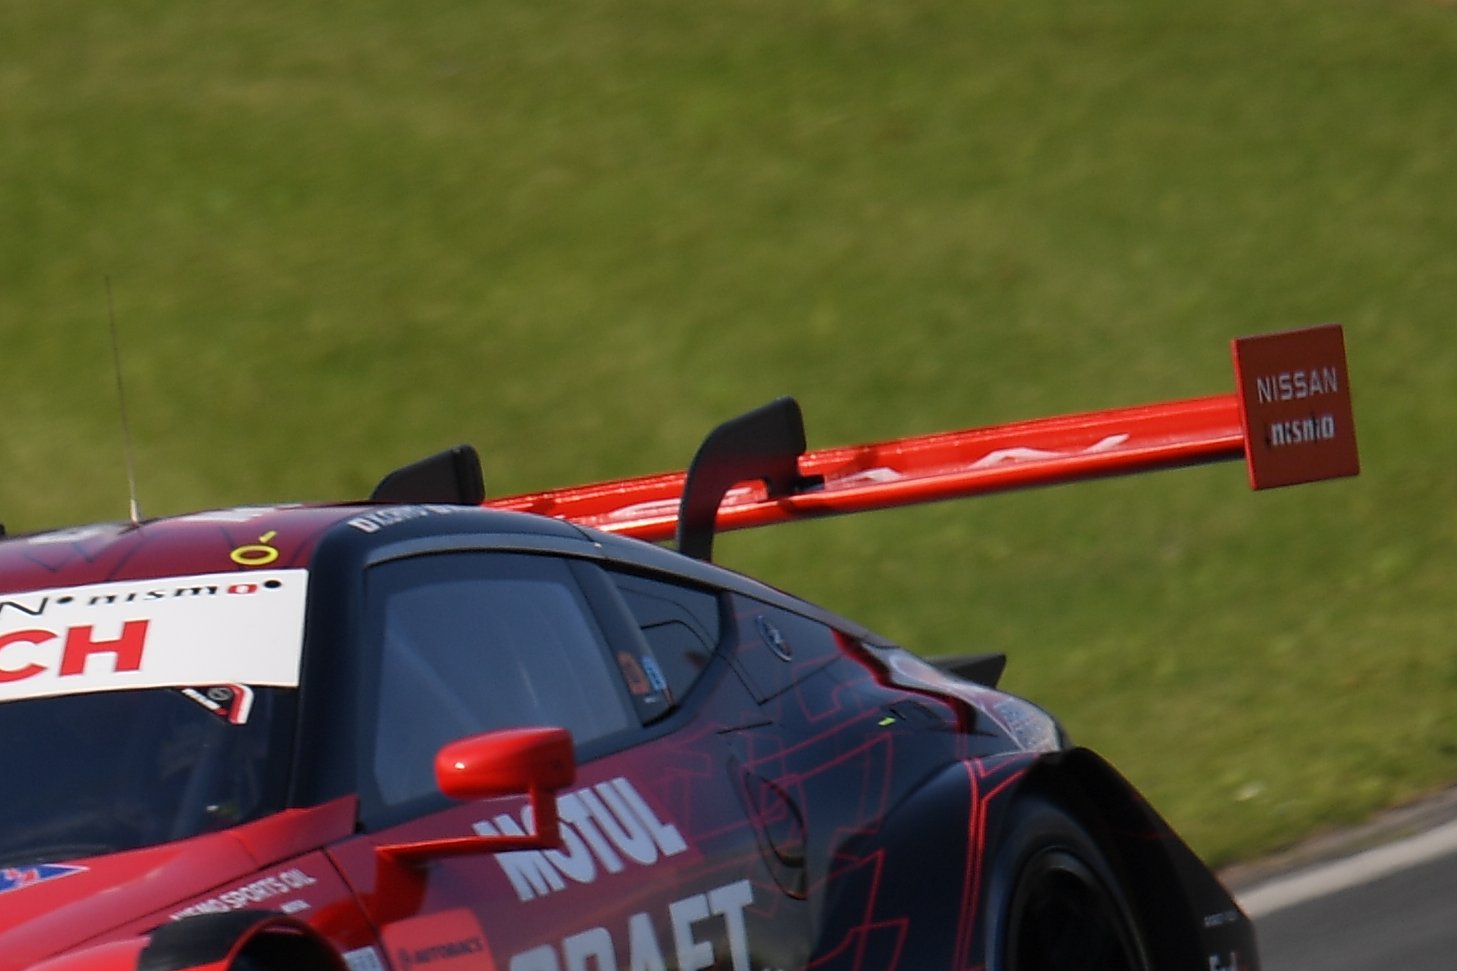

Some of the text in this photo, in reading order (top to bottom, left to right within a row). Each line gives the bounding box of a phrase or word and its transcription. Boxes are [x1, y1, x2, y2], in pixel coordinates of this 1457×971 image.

[1256, 367, 1338, 404] NISSAN
[1271, 415, 1335, 446] nismo
[88, 583, 258, 606] nismo
[474, 777, 686, 901] MOTUL
